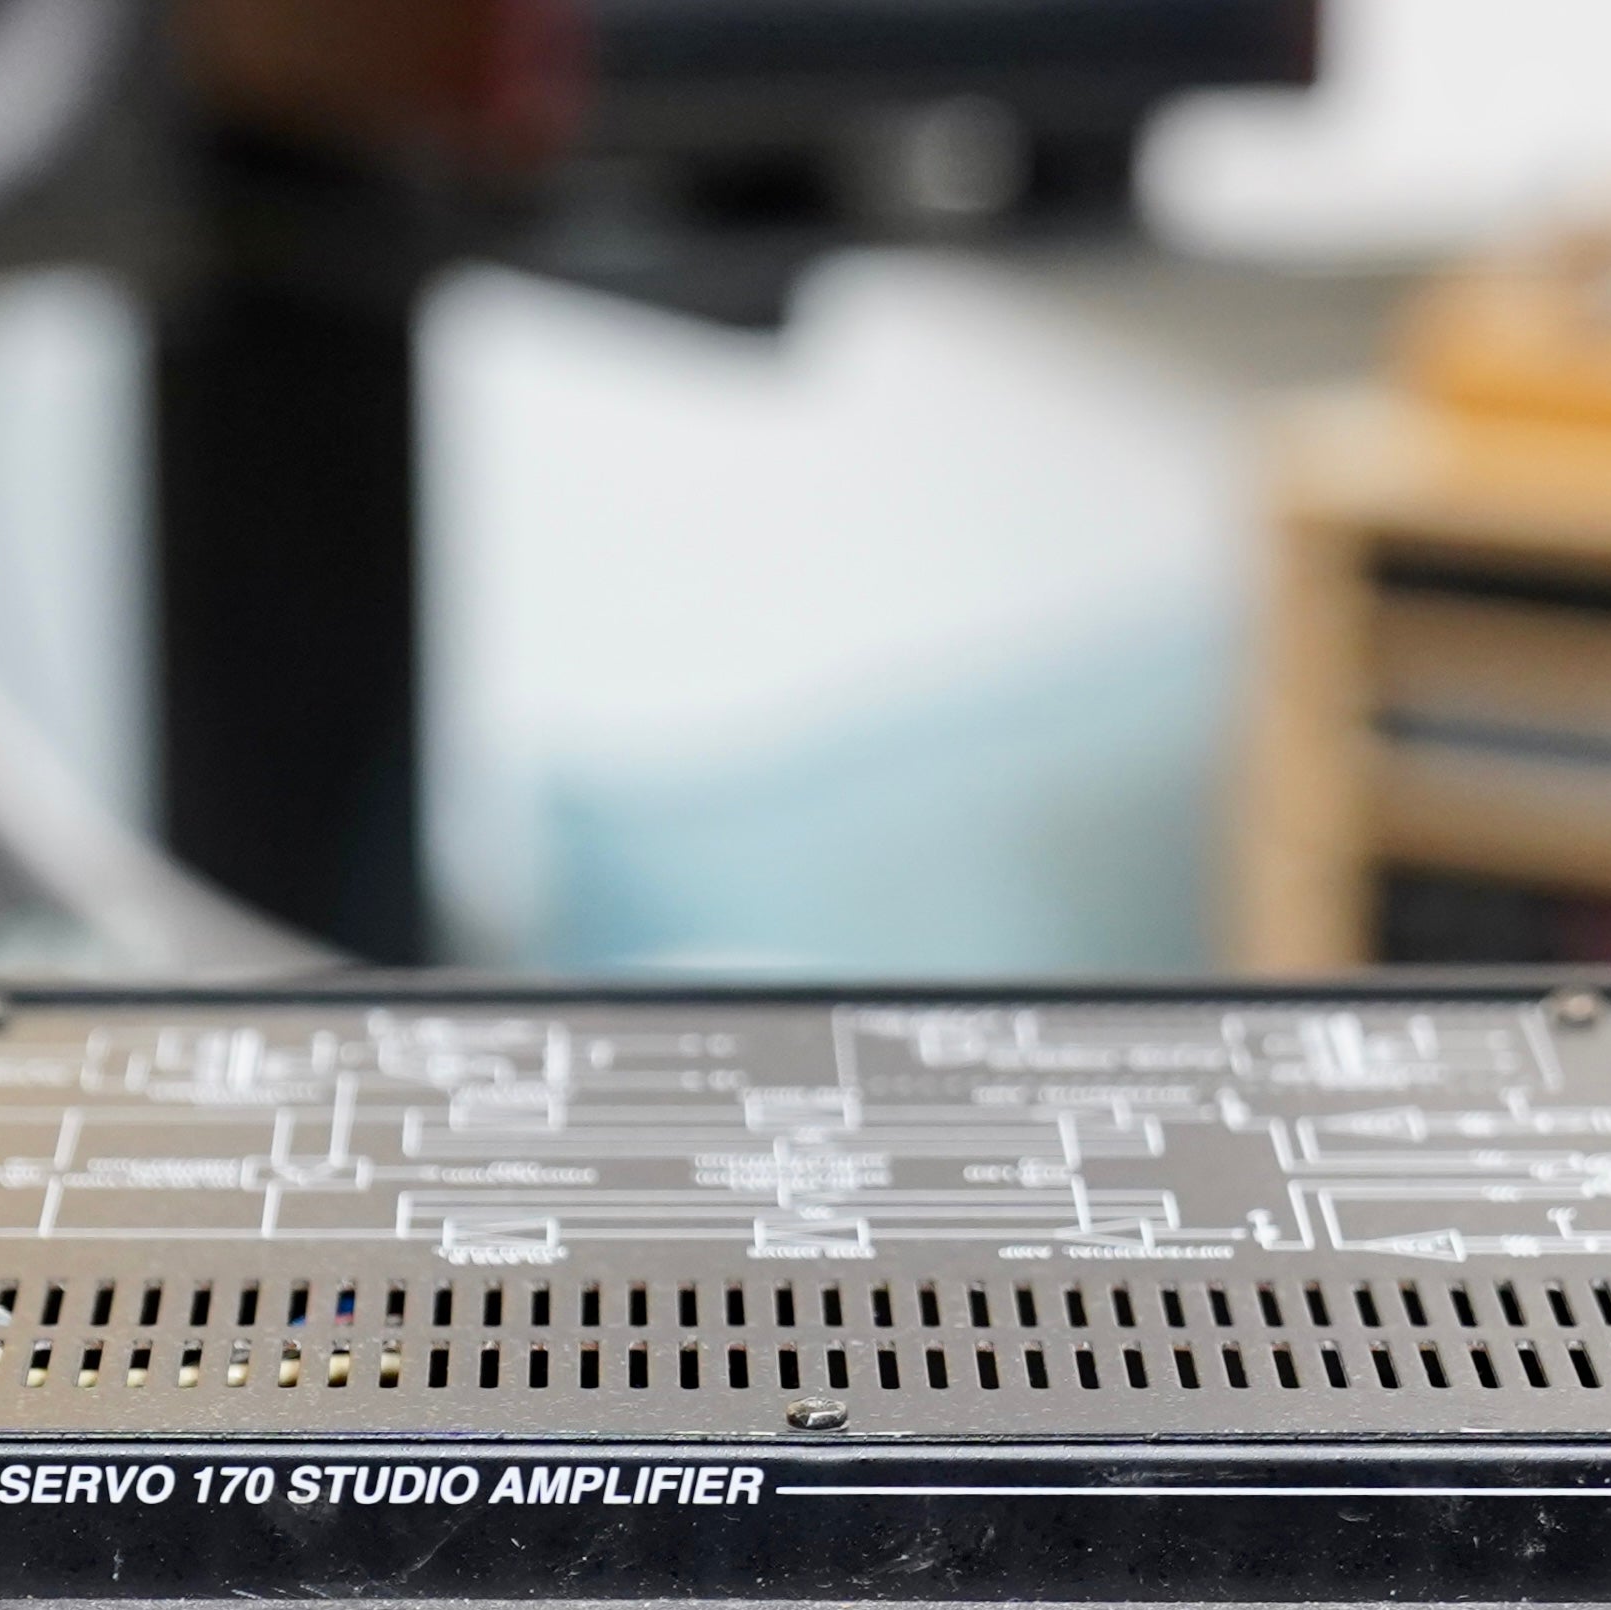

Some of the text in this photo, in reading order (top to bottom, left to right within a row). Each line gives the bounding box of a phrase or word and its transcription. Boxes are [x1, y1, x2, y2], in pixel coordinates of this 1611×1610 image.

[194, 1466, 275, 1504] 170
[287, 1465, 479, 1504] STUDIO
[488, 1466, 764, 1504] AMPLIFIER
